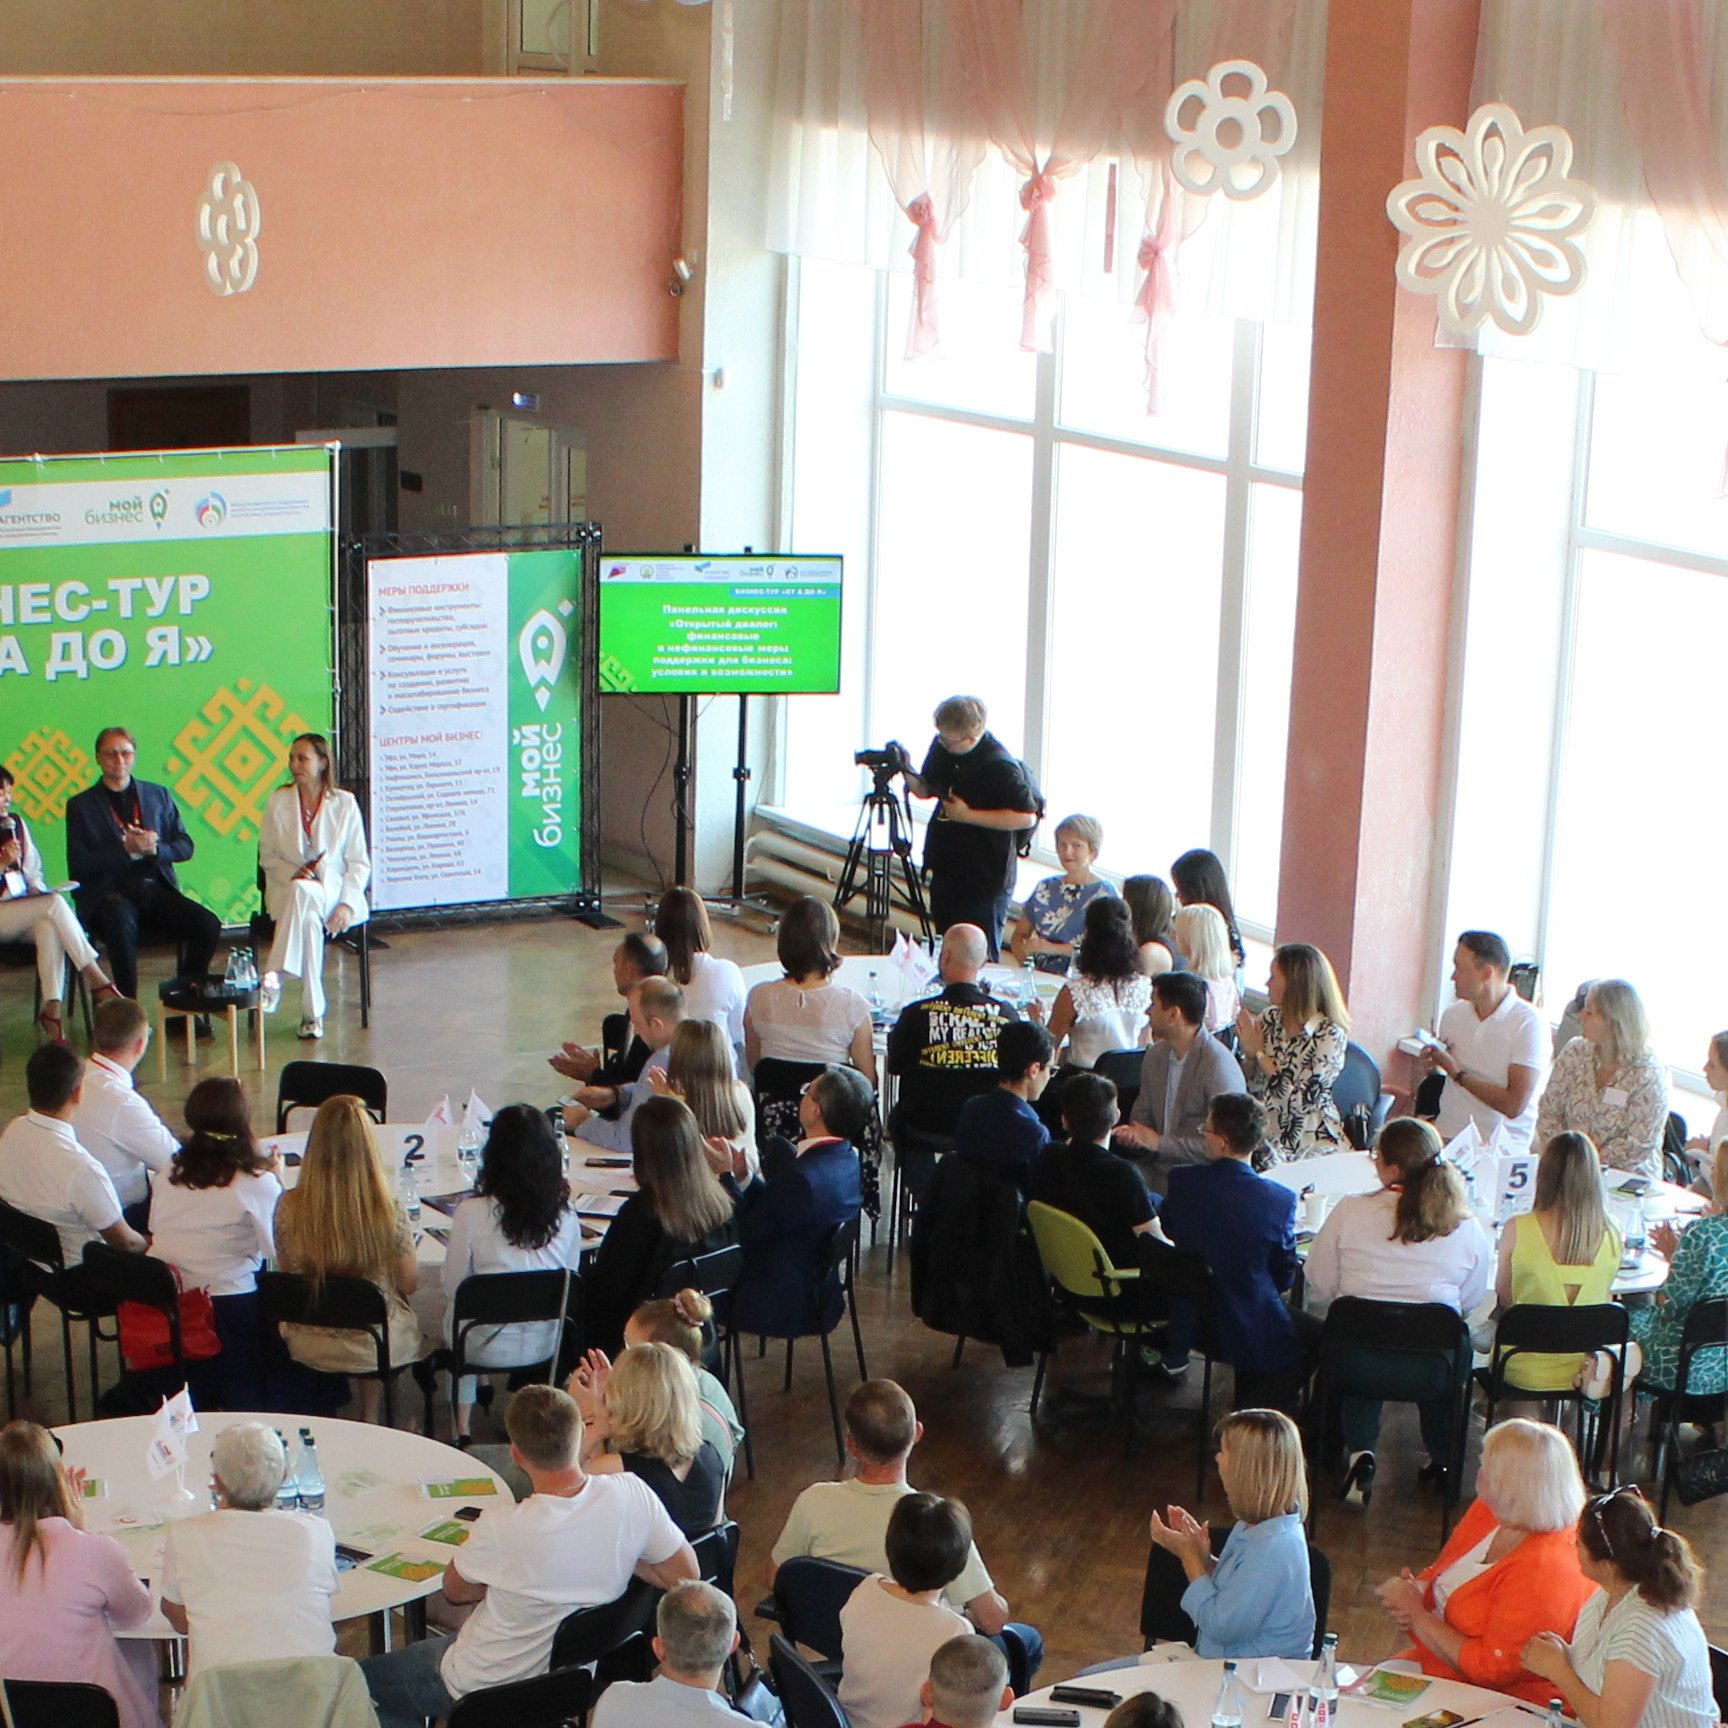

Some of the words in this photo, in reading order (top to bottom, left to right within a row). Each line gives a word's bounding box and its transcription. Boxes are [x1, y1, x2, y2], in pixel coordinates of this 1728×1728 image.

[378, 585, 406, 596] МЕРЫ
[408, 582, 469, 595] ПОДДЕРЖКИ
[662, 604, 725, 614] Панельная
[727, 605, 787, 616] дискуссия
[669, 619, 732, 630] «Открытый
[686, 631, 760, 642] финансовые
[45, 628, 128, 681] ДО
[144, 625, 214, 667] Я»
[667, 642, 754, 654] нефинансовые
[758, 644, 789, 655] меры
[653, 656, 716, 666] поддержки
[718, 656, 739, 666] для
[379, 734, 418, 747] ЦЕНТРЫ
[420, 731, 442, 743] МОЙ
[533, 722, 562, 848] бизнес
[929, 1026, 950, 1044] MY
[404, 1134, 425, 1162] 2
[1508, 1162, 1529, 1189] 5
